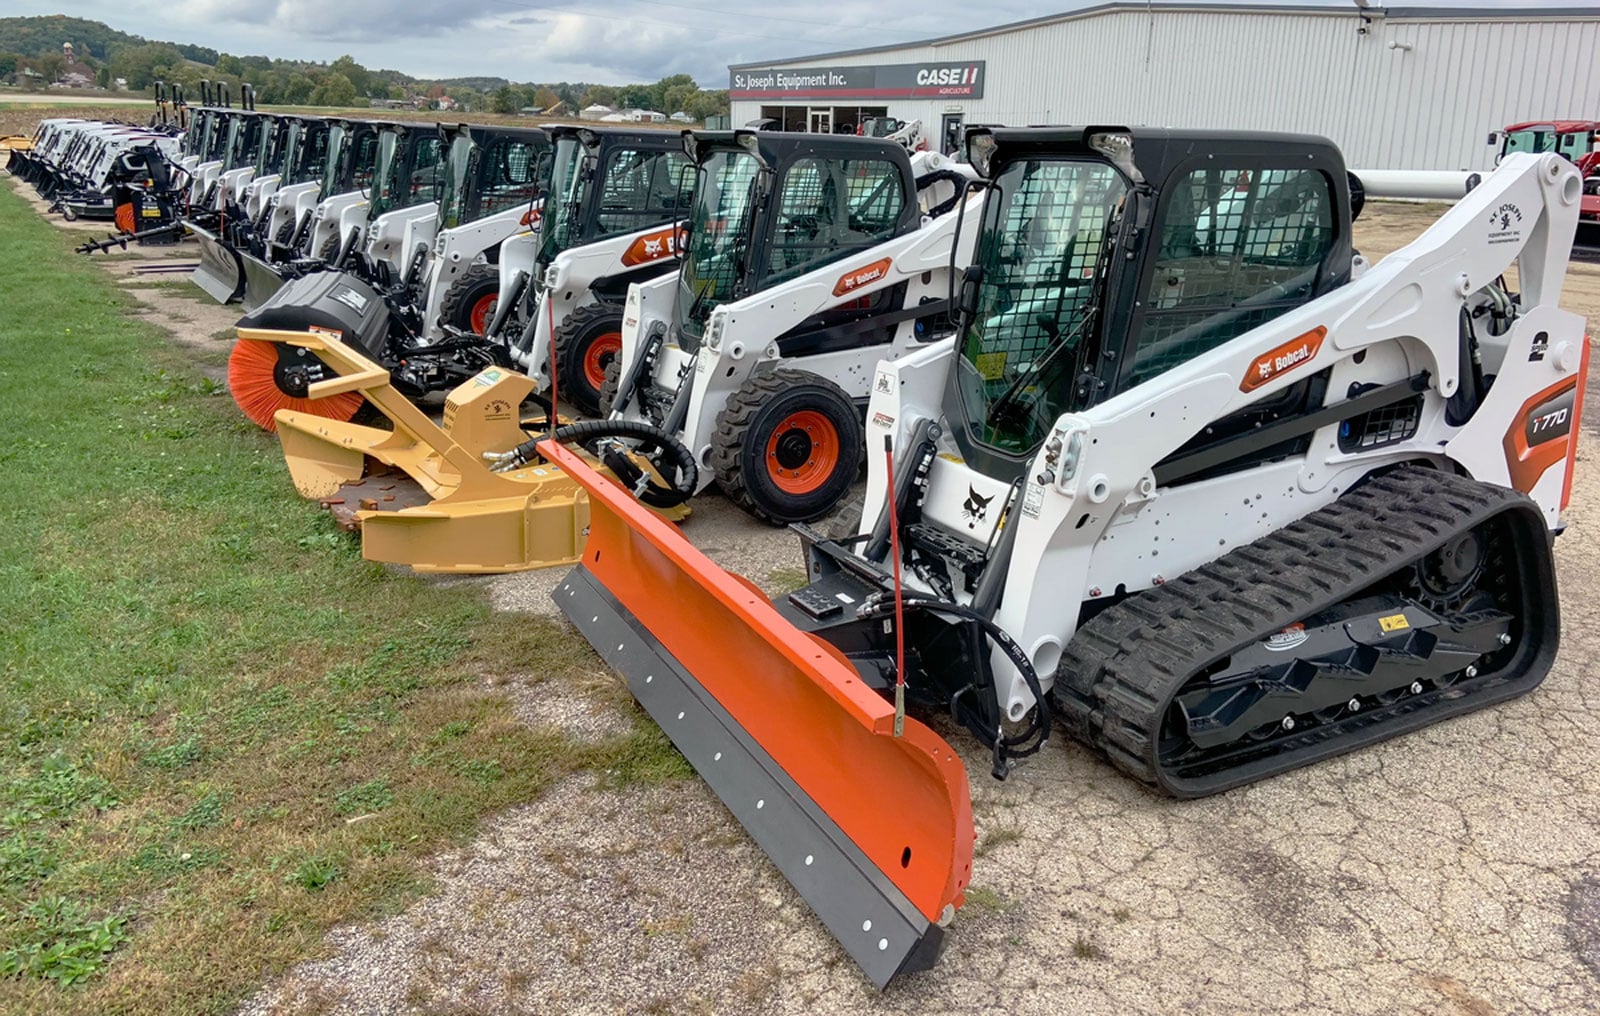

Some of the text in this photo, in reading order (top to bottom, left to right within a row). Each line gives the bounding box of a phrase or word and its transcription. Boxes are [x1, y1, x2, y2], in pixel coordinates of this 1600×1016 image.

[735, 71, 847, 91] St. Joseph Equipment Inc.
[917, 68, 961, 86] CASE
[856, 268, 881, 285] Bobcat
[1275, 344, 1310, 372] Bobcat
[1528, 331, 1549, 362] 2
[1533, 407, 1568, 433] T770
